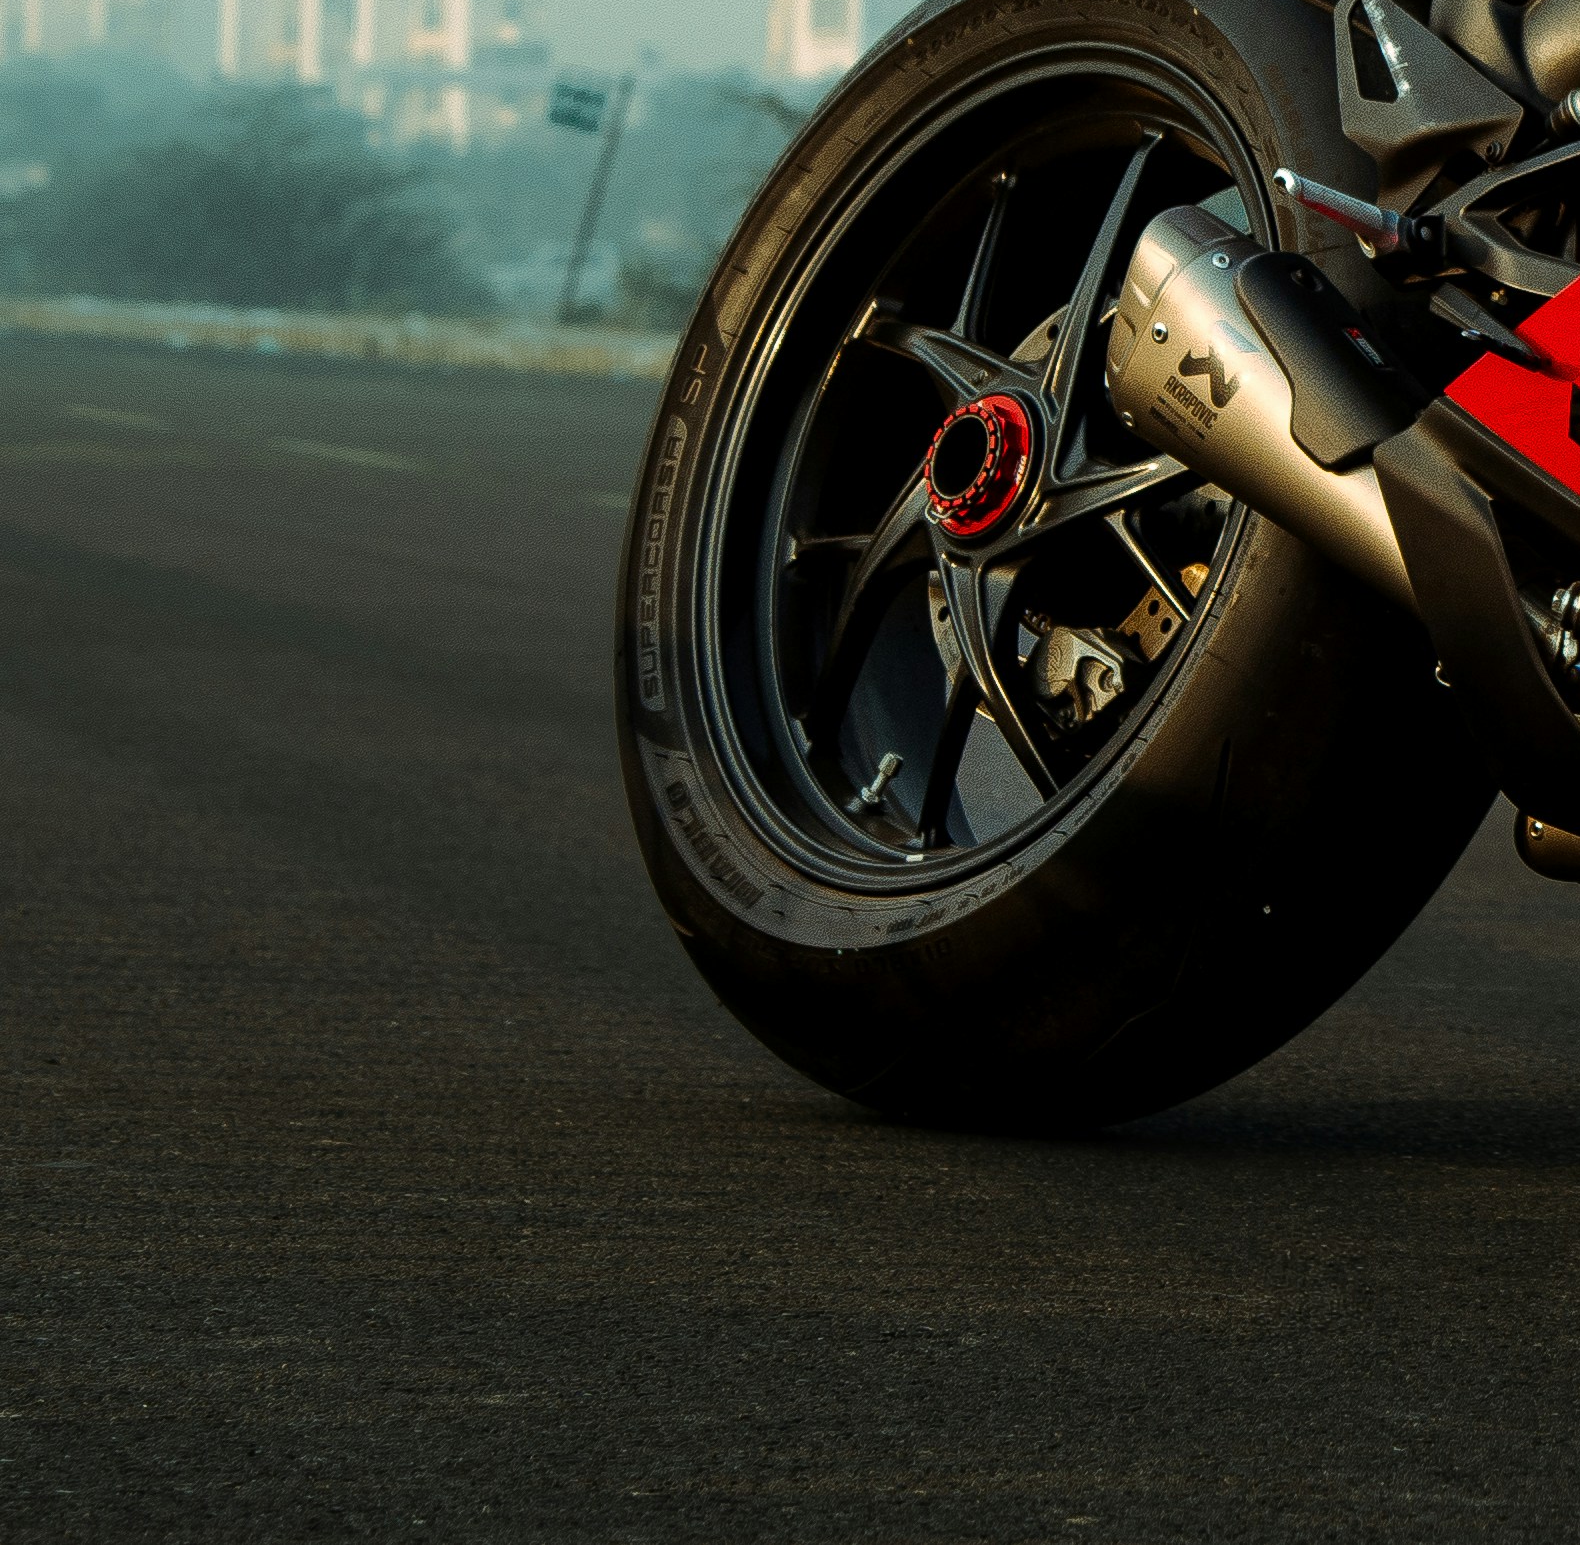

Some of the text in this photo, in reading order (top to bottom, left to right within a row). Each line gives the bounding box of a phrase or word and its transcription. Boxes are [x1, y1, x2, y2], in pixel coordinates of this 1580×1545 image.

[640, 342, 709, 701] SUPERCORSA SP
[664, 779, 764, 910] DIABLO
